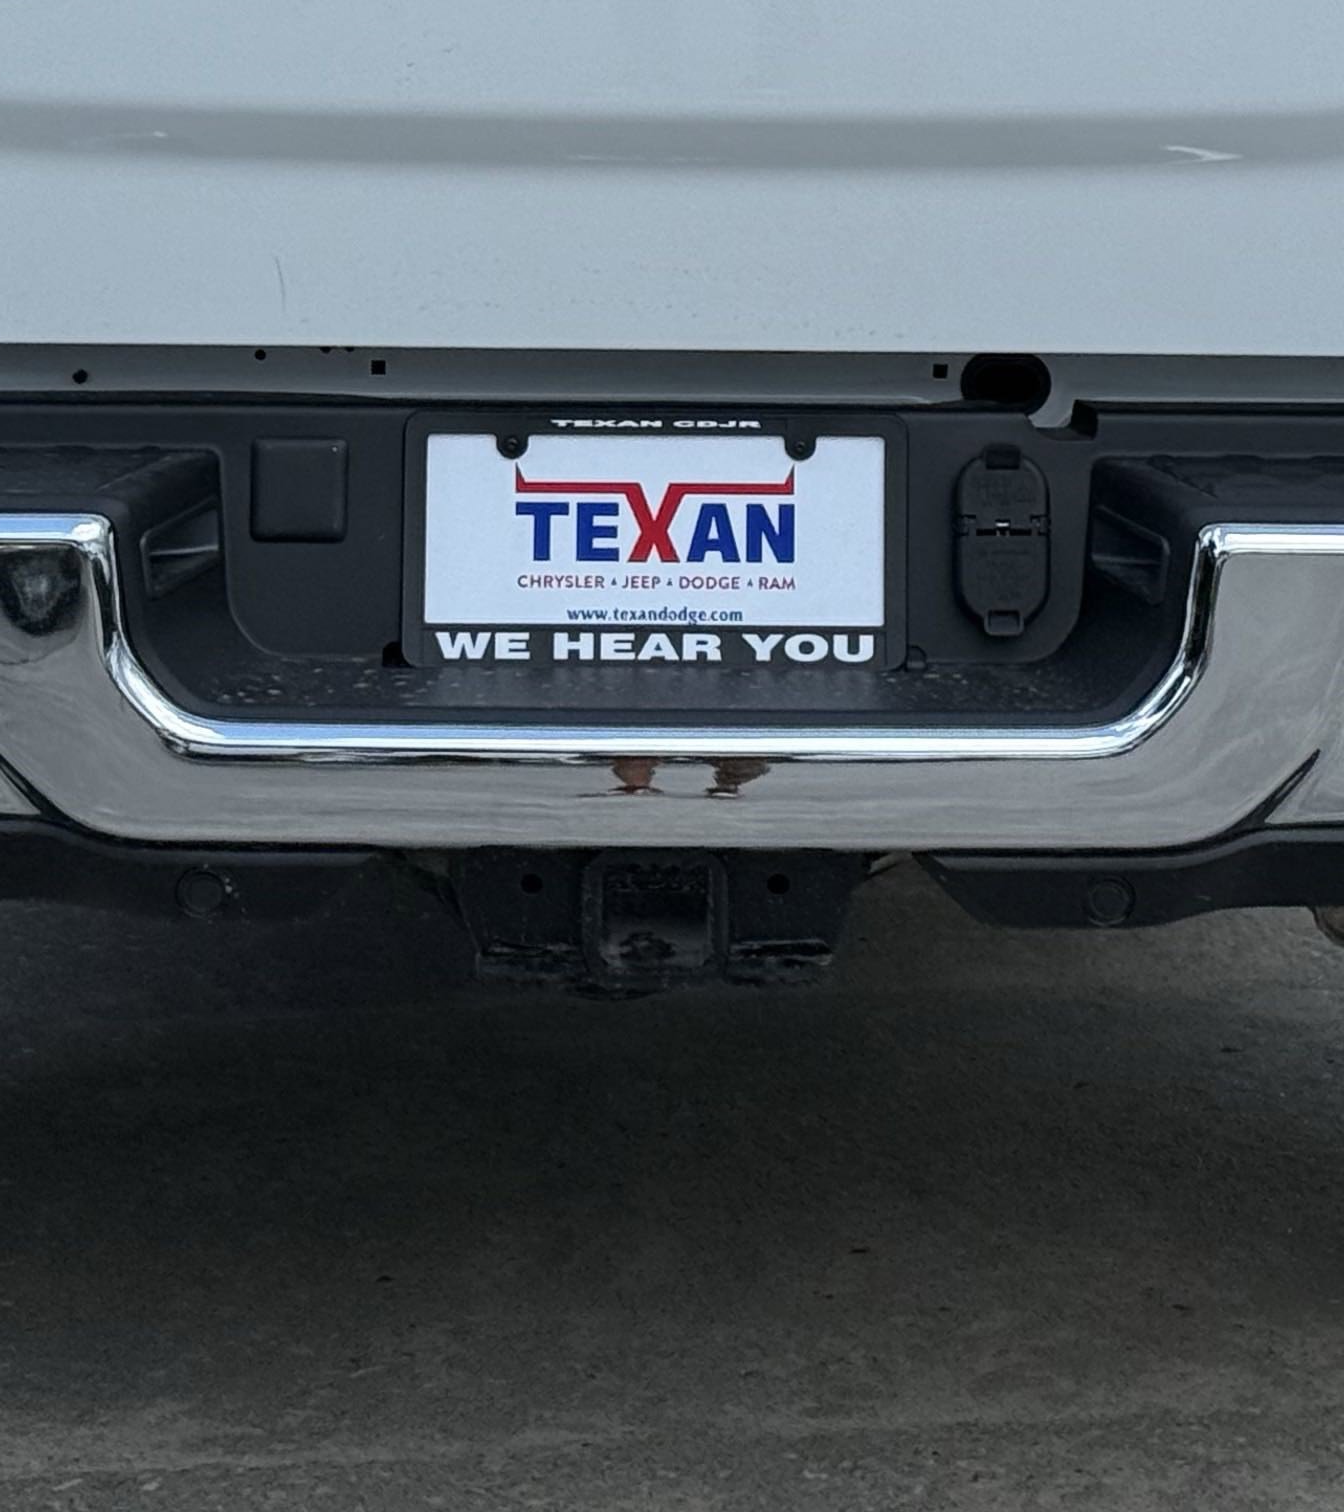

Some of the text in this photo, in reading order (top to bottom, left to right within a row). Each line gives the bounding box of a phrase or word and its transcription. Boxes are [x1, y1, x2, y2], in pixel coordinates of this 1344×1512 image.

[550, 419, 762, 429] TEXAN CDJR
[515, 482, 796, 563] TEXAN
[517, 575, 796, 591] CHRYSLER JEEP DODGE RAM
[567, 606, 743, 625] www.texandodge.com
[436, 631, 875, 663] WE HEAR YOU
